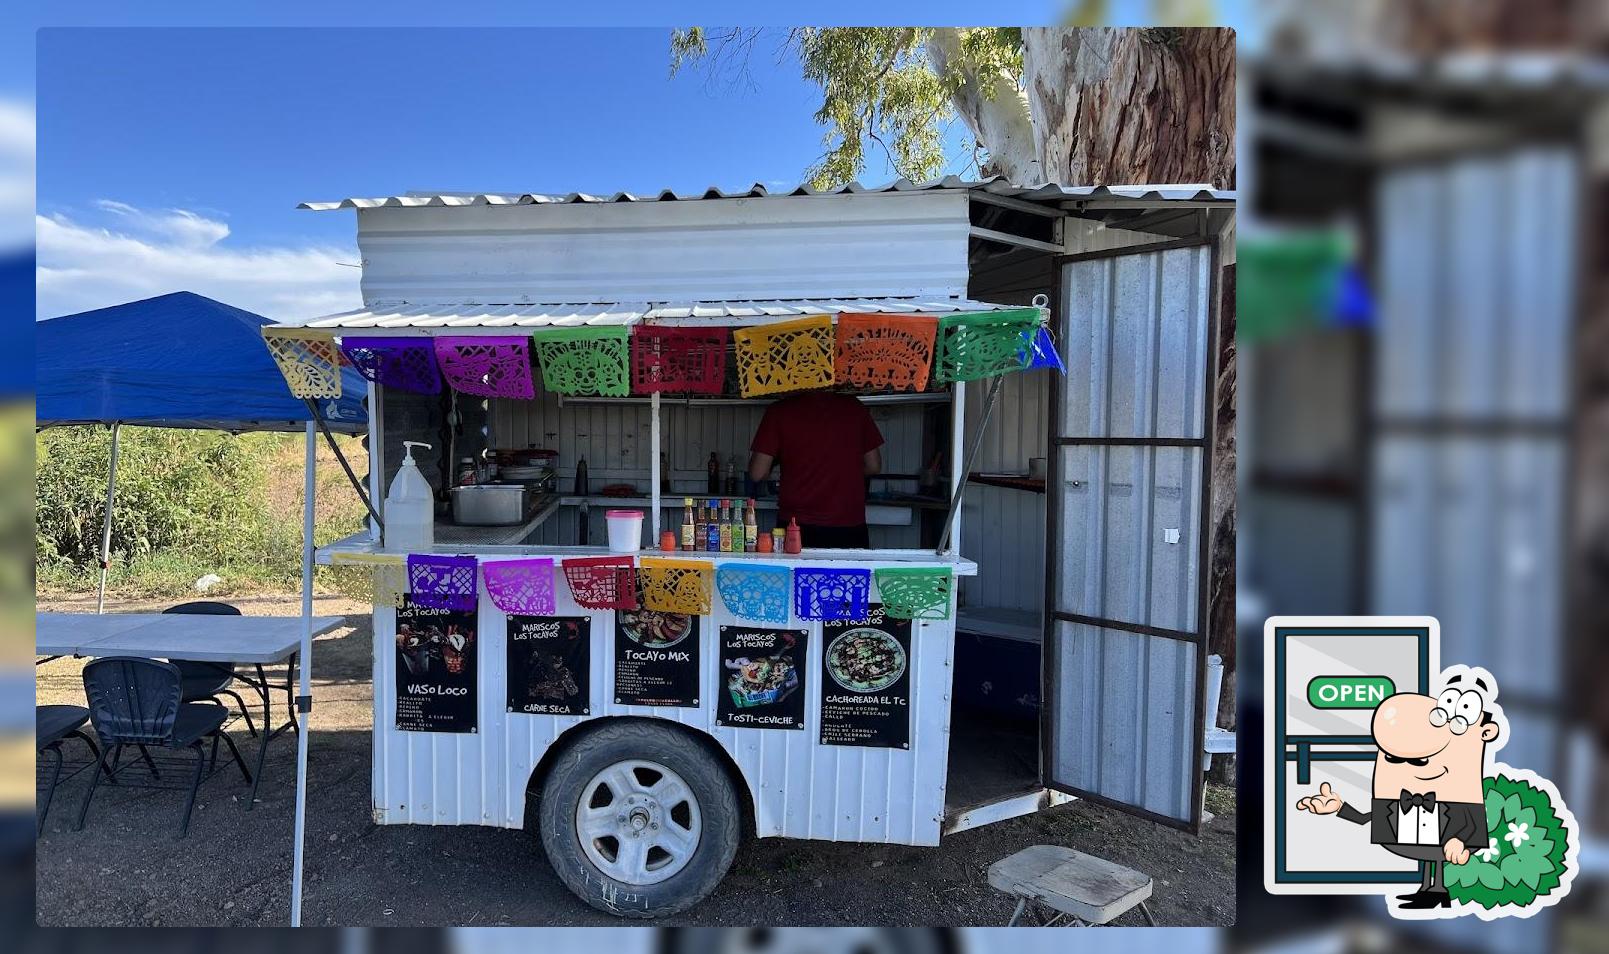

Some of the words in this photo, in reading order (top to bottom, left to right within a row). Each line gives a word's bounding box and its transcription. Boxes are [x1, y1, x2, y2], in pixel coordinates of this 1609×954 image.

[397, 609, 413, 617] LOS
[414, 608, 450, 616] TOCAYOS
[522, 621, 560, 632] MARISCOS
[824, 618, 842, 627] LOS
[844, 616, 883, 626] TOCAYOS
[528, 630, 558, 639] TOCAYOS
[736, 633, 776, 641] MARISCOS
[625, 650, 666, 661] TOCAYO
[668, 652, 689, 662] MIX
[408, 684, 435, 695] VASO
[438, 685, 467, 695] LOCO
[825, 695, 879, 704] CACHOREADA
[881, 696, 891, 704] EL
[524, 704, 547, 712] CARNE
[549, 705, 570, 713] SECA
[727, 713, 793, 725] TOSTI-CEVICHE
